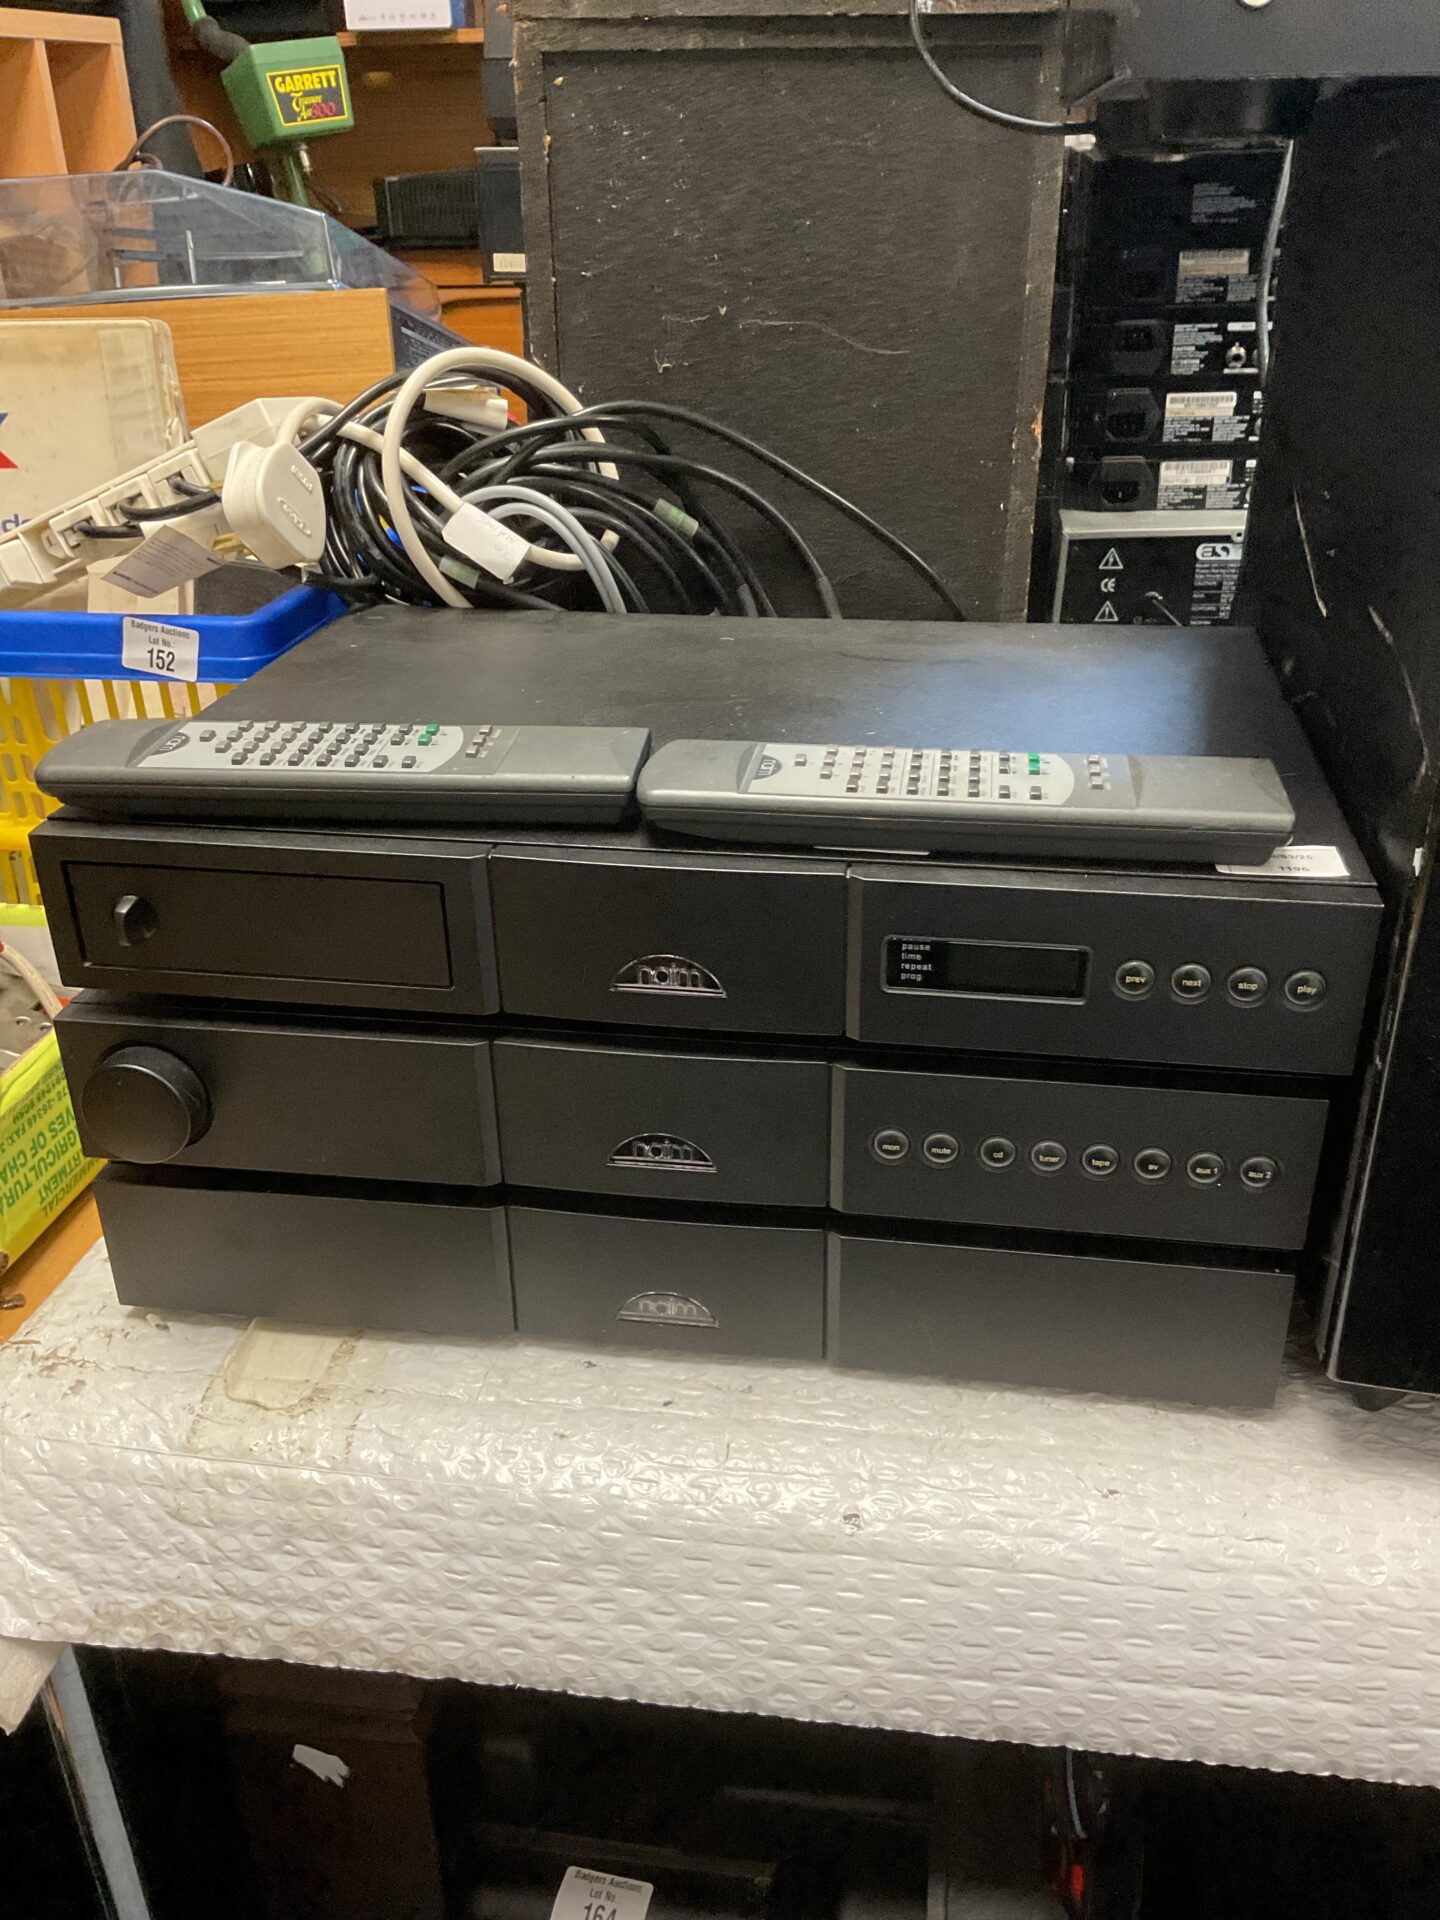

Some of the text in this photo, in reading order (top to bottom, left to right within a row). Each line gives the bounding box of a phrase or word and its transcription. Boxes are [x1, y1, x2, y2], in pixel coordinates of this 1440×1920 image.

[274, 70, 337, 93] GARRETT
[131, 620, 190, 640] Badgers Auctions
[148, 635, 160, 645] Lot
[147, 648, 175, 672] 152
[901, 943, 931, 951] pause
[901, 952, 922, 960] time
[901, 963, 932, 971] repeat
[638, 963, 702, 988] naim
[900, 973, 922, 982] prog
[1182, 979, 1201, 987] next
[1238, 982, 1258, 991] stop
[1297, 985, 1317, 995] play
[30, 1131, 47, 1159] OF
[633, 1138, 693, 1160] naim
[1039, 1155, 1060, 1163] tuner
[1091, 1159, 1110, 1167] tape
[1196, 1166, 1211, 1174] aux
[1248, 1170, 1264, 1178] aux
[640, 1298, 697, 1318] naim
[574, 1869, 644, 1893] Badgers Auctions
[589, 1887, 603, 1899] Lot
